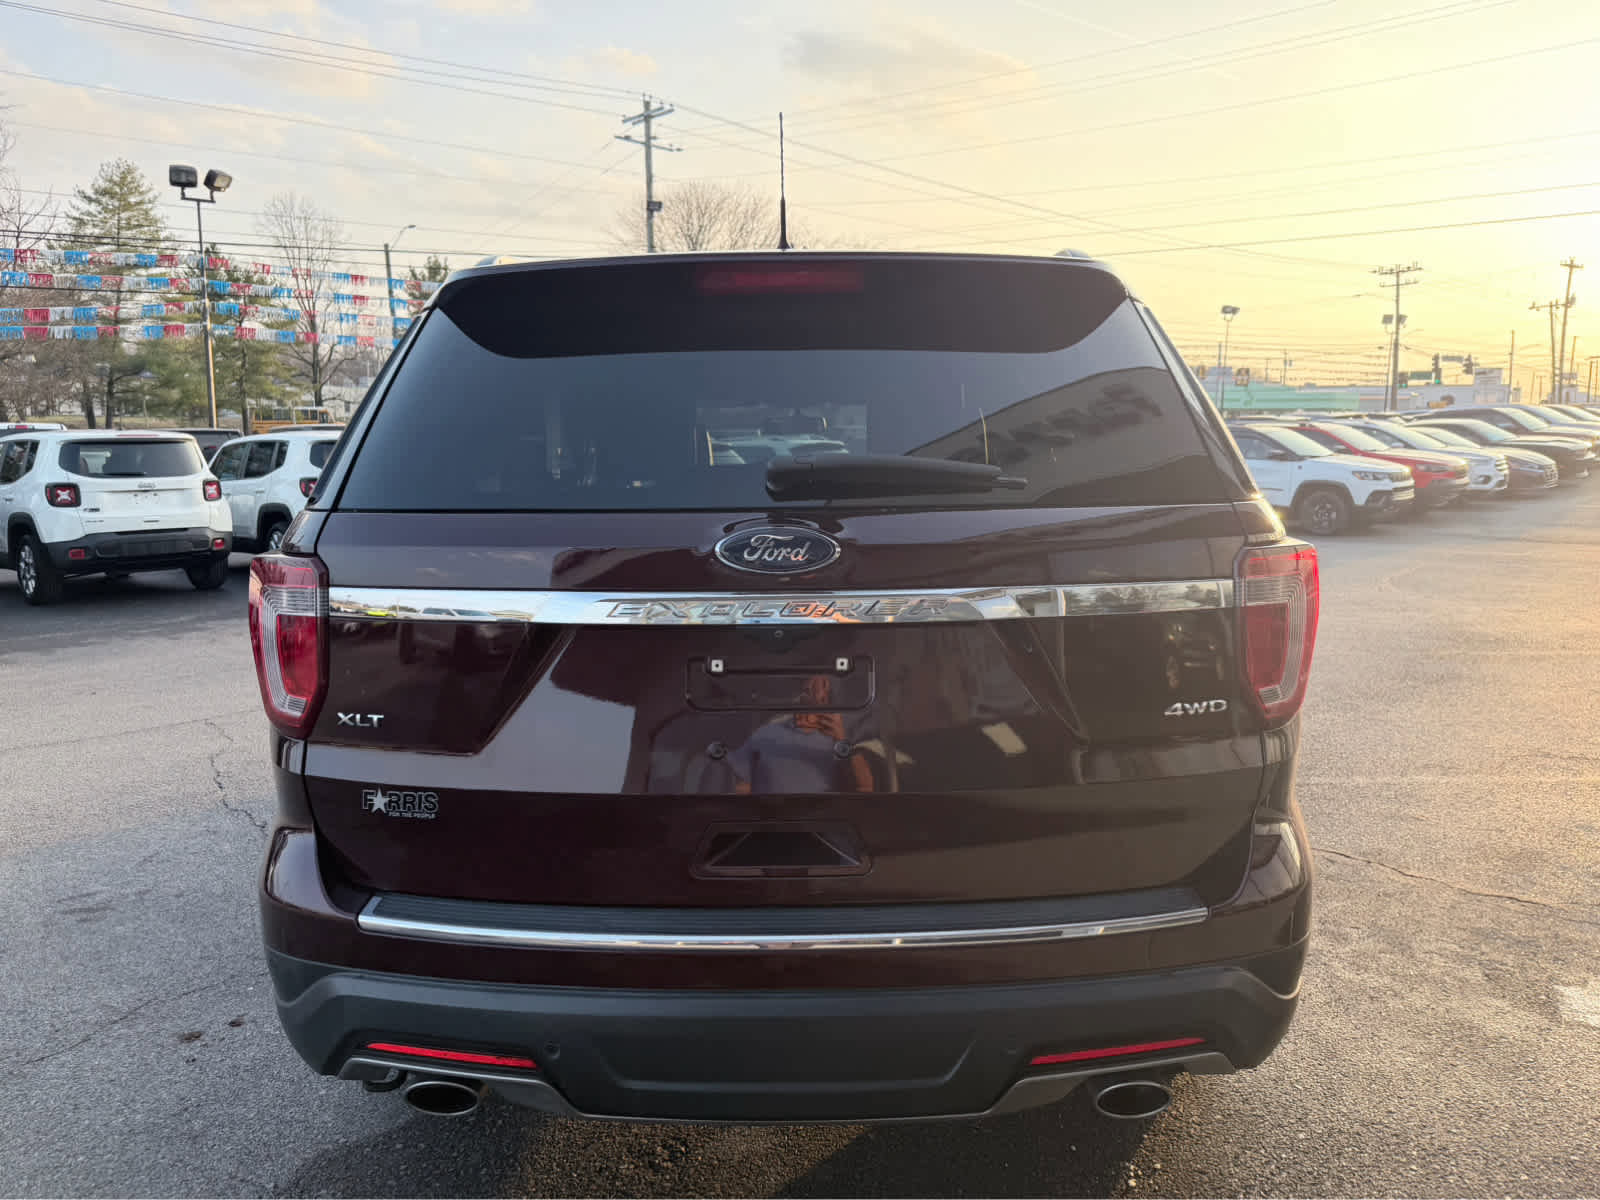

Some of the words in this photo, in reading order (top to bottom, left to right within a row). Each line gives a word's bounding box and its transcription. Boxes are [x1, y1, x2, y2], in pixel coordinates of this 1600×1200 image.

[743, 533, 811, 562] Ford
[606, 598, 951, 619] EXPLORER
[1164, 699, 1228, 716] 4WD
[337, 712, 384, 727] XLT
